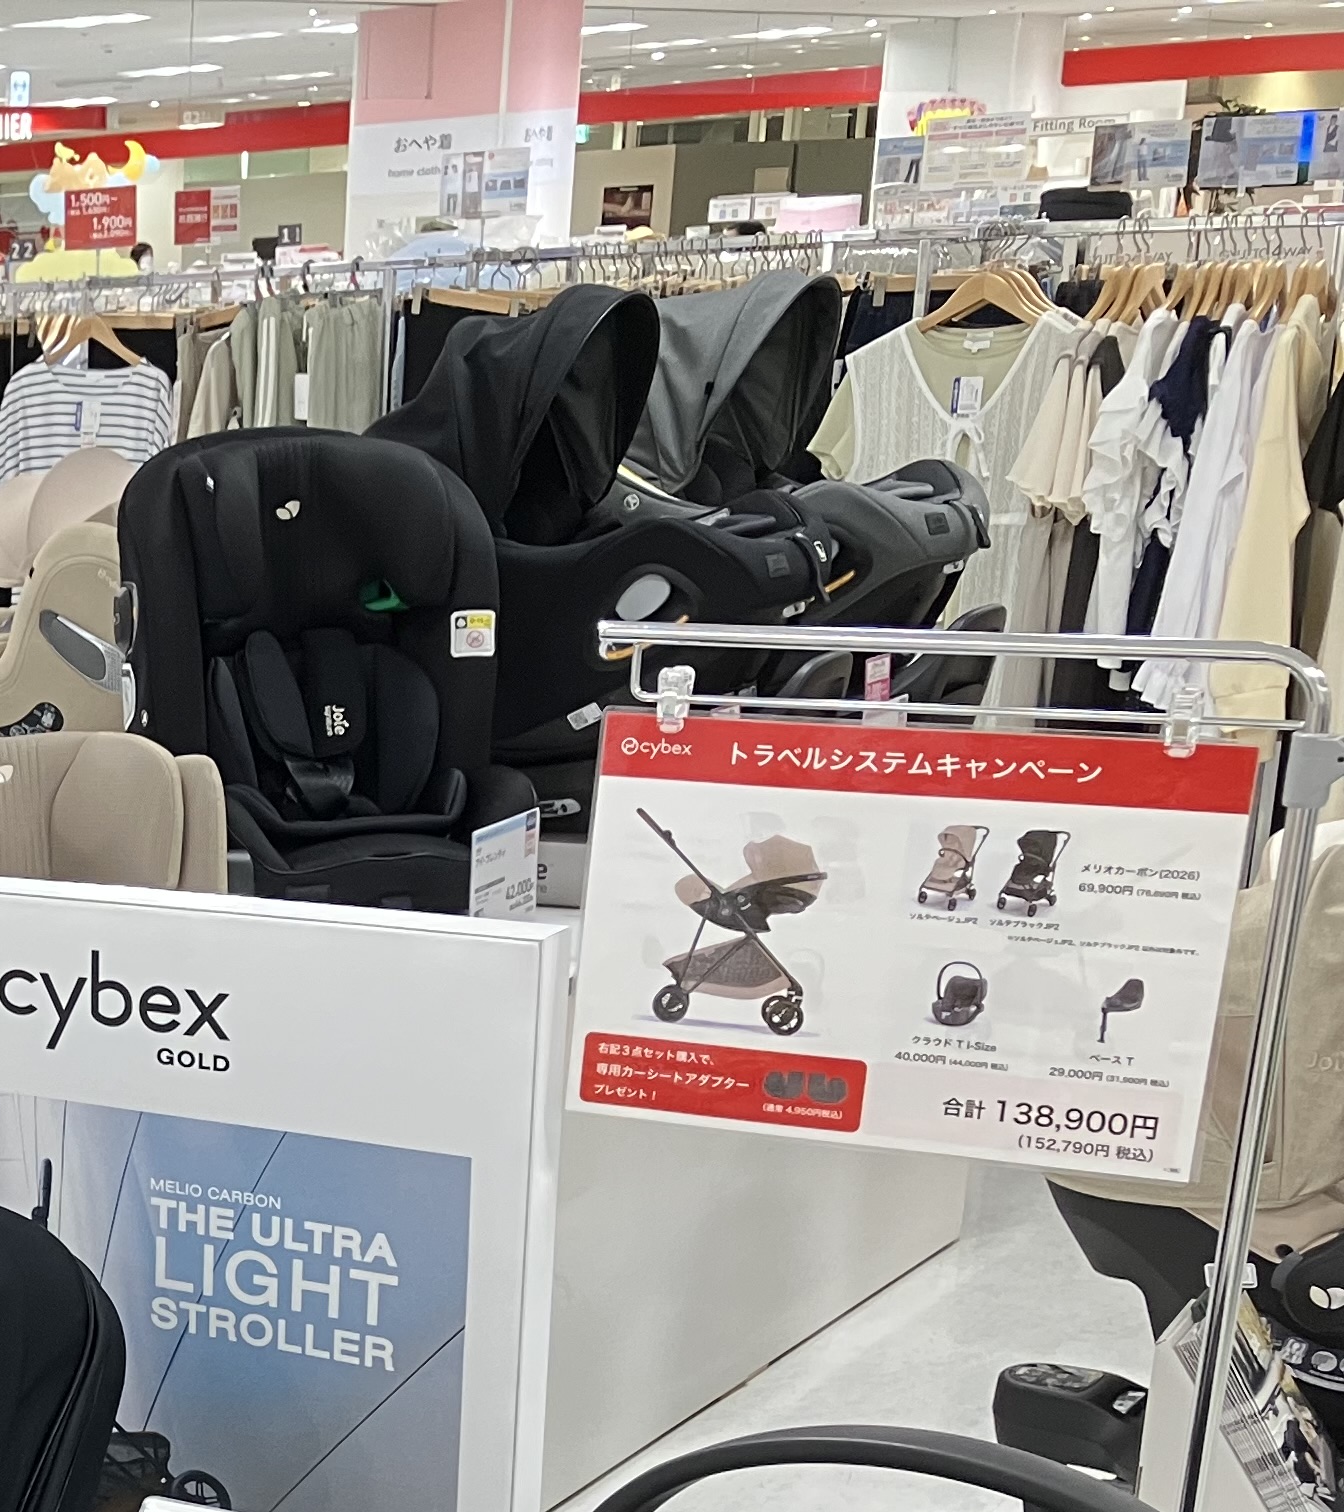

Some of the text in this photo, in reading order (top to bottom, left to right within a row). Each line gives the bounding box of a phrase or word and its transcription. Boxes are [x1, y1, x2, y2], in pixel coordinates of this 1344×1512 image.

[332, 704, 350, 735] Joie
[640, 738, 1102, 784] cybex トラベルシステムキャンペーン
[156, 1047, 230, 1073] GOLD
[1089, 1054, 1122, 1065] ベース
[943, 1097, 1160, 1140] 合計 138,900円
[1018, 1134, 1110, 1158] (152,790円
[149, 1175, 282, 1211] MELIO CARBON
[150, 1197, 399, 1268] THE ULTRA
[152, 1234, 400, 1328] LIGHT
[149, 1296, 396, 1373] STROLLER
